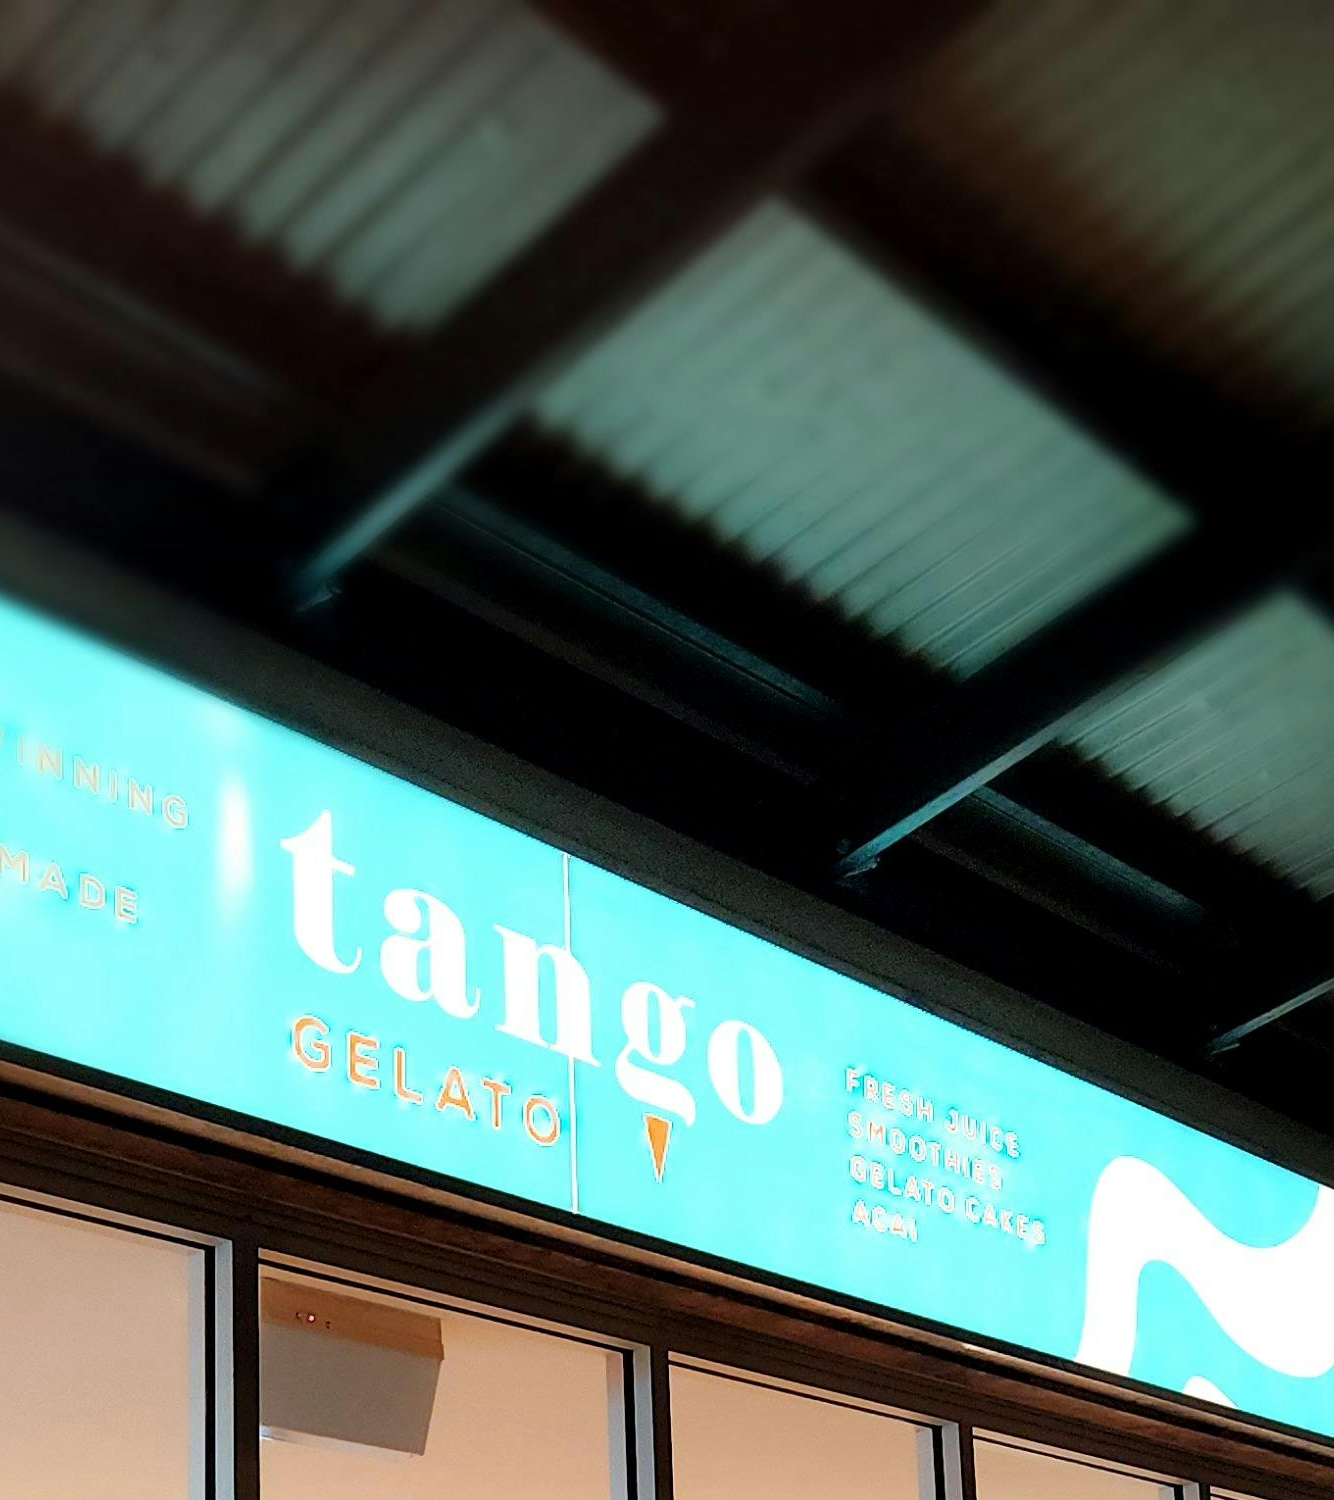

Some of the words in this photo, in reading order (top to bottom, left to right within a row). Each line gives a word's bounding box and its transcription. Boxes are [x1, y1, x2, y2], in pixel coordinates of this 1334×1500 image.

[279, 809, 784, 1129] tango
[291, 1017, 563, 1146] GELATO
[845, 1066, 934, 1123] FRESH
[944, 1108, 1021, 1159] JUICE
[847, 1110, 1004, 1191] SMOOTHIES
[849, 1155, 956, 1214] GELATO
[965, 1196, 1046, 1245] CAKES
